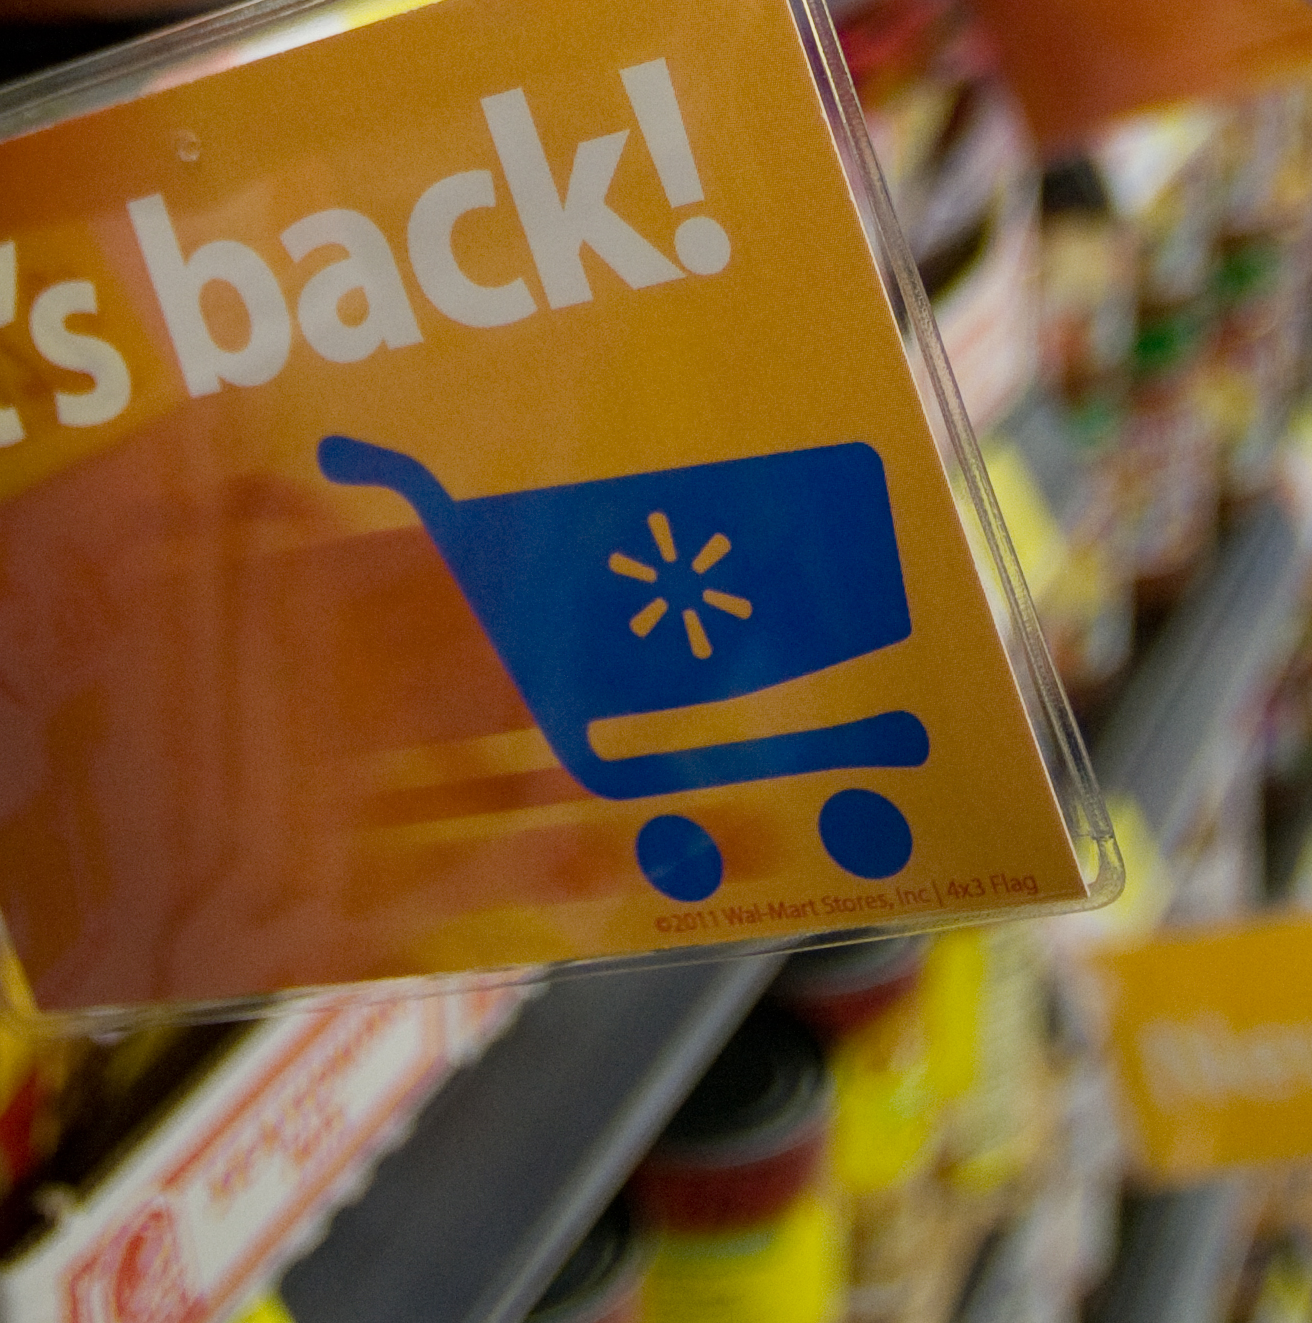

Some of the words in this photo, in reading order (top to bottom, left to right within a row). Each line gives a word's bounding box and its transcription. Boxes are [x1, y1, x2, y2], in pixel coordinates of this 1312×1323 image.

[127, 56, 732, 399] back!
[722, 899, 820, 926] Wal-Mart
[820, 893, 895, 915] Stores,
[895, 887, 930, 906] Inc
[947, 878, 987, 900] 4x3
[989, 873, 1039, 896] Flag
